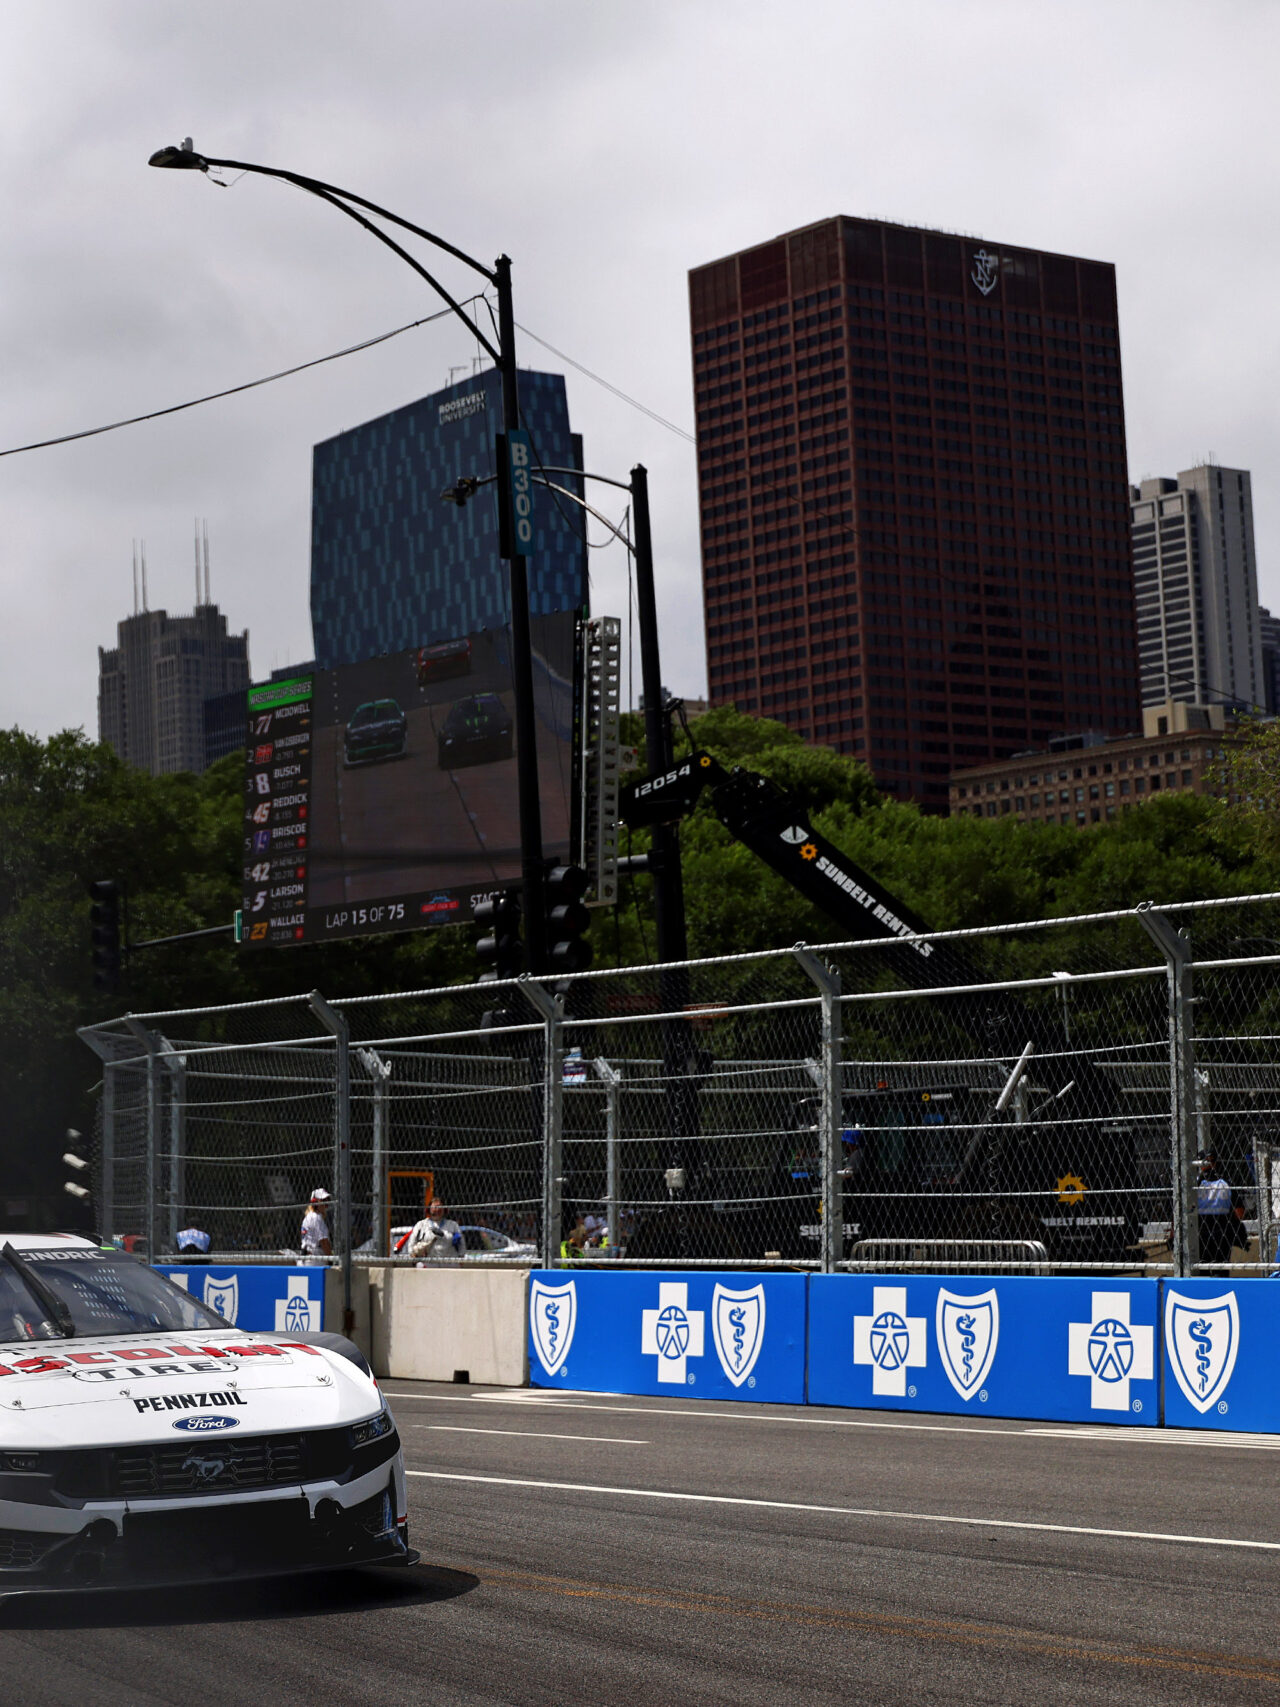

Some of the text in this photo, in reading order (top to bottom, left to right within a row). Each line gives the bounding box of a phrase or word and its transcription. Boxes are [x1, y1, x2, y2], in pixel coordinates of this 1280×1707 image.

[438, 390, 486, 414] ROOSEVELT
[439, 402, 486, 426] UNIVERSITY
[255, 773, 270, 794] 8
[273, 764, 301, 778] BUSCH
[253, 802, 272, 824] 45
[273, 793, 307, 808] REDDICK
[272, 822, 307, 838] BRISCOE
[252, 862, 270, 882] 42
[816, 856, 876, 909] SUNBELT
[251, 890, 268, 912] 5
[270, 883, 304, 898] LARSON
[270, 913, 305, 927] WALLACE
[326, 912, 348, 929] LAP
[352, 909, 367, 925] 15
[370, 907, 384, 923] OF
[388, 904, 405, 920] 75
[1075, 1216, 1125, 1226] RENTALS
[88, 1361, 222, 1380] TIRE
[133, 1391, 248, 1413] PENNZOIL
[187, 1416, 228, 1430] Ford
